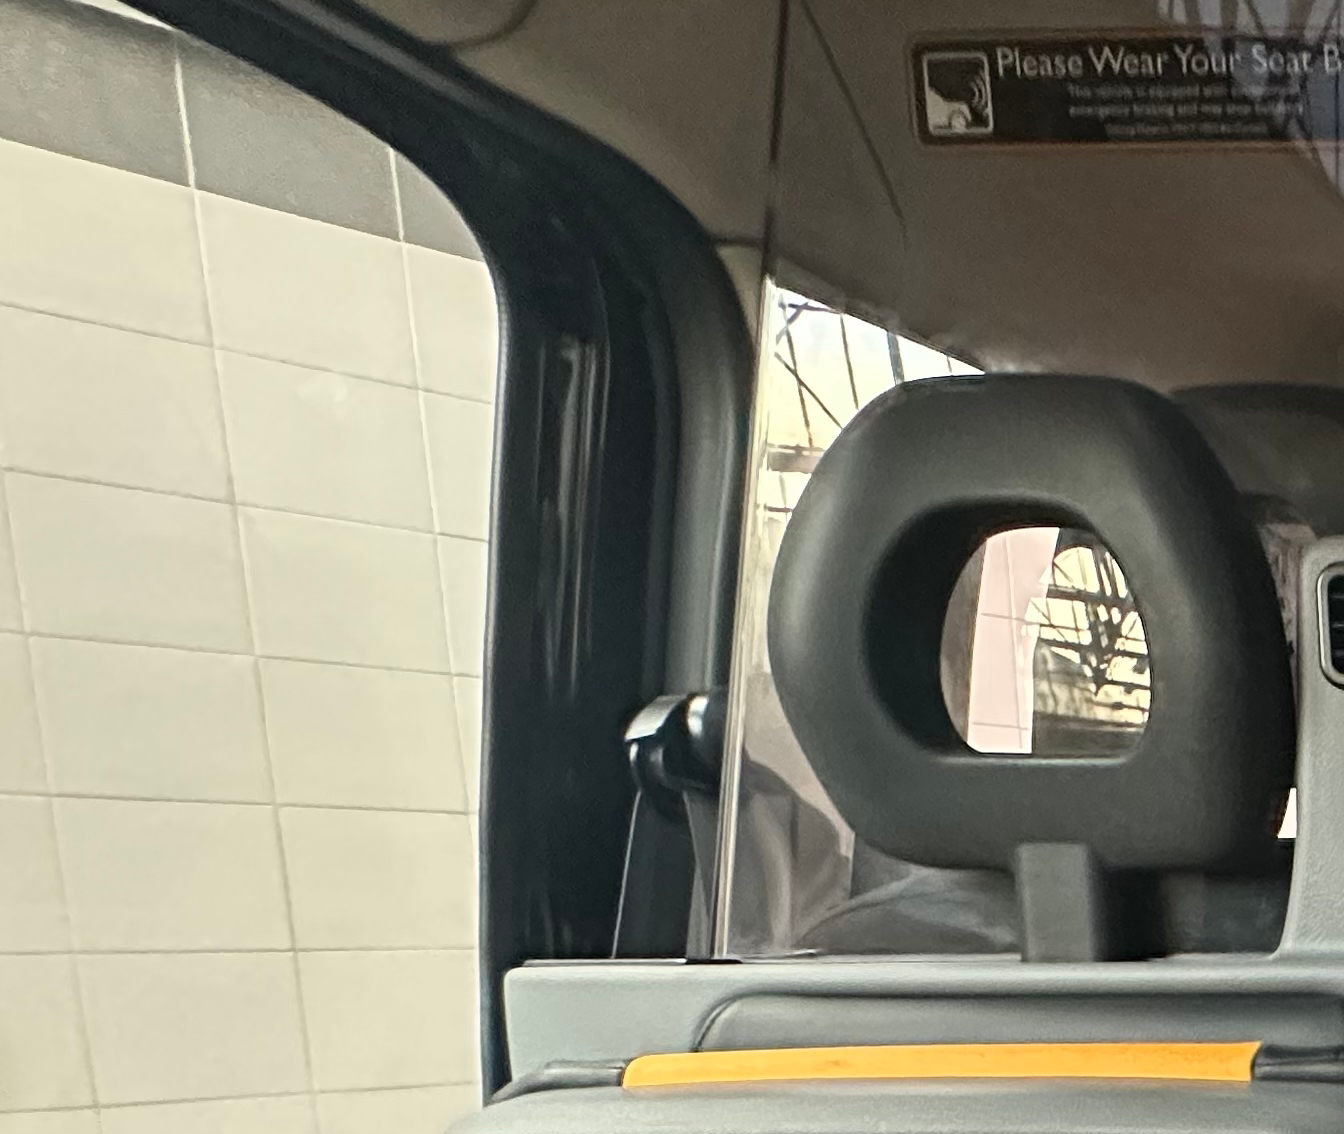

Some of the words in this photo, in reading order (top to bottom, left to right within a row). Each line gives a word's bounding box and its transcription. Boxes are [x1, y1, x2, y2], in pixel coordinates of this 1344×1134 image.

[995, 45, 1084, 79] Please
[1087, 44, 1169, 77] Wear
[1173, 43, 1242, 76] Your
[1250, 42, 1314, 75] Seat
